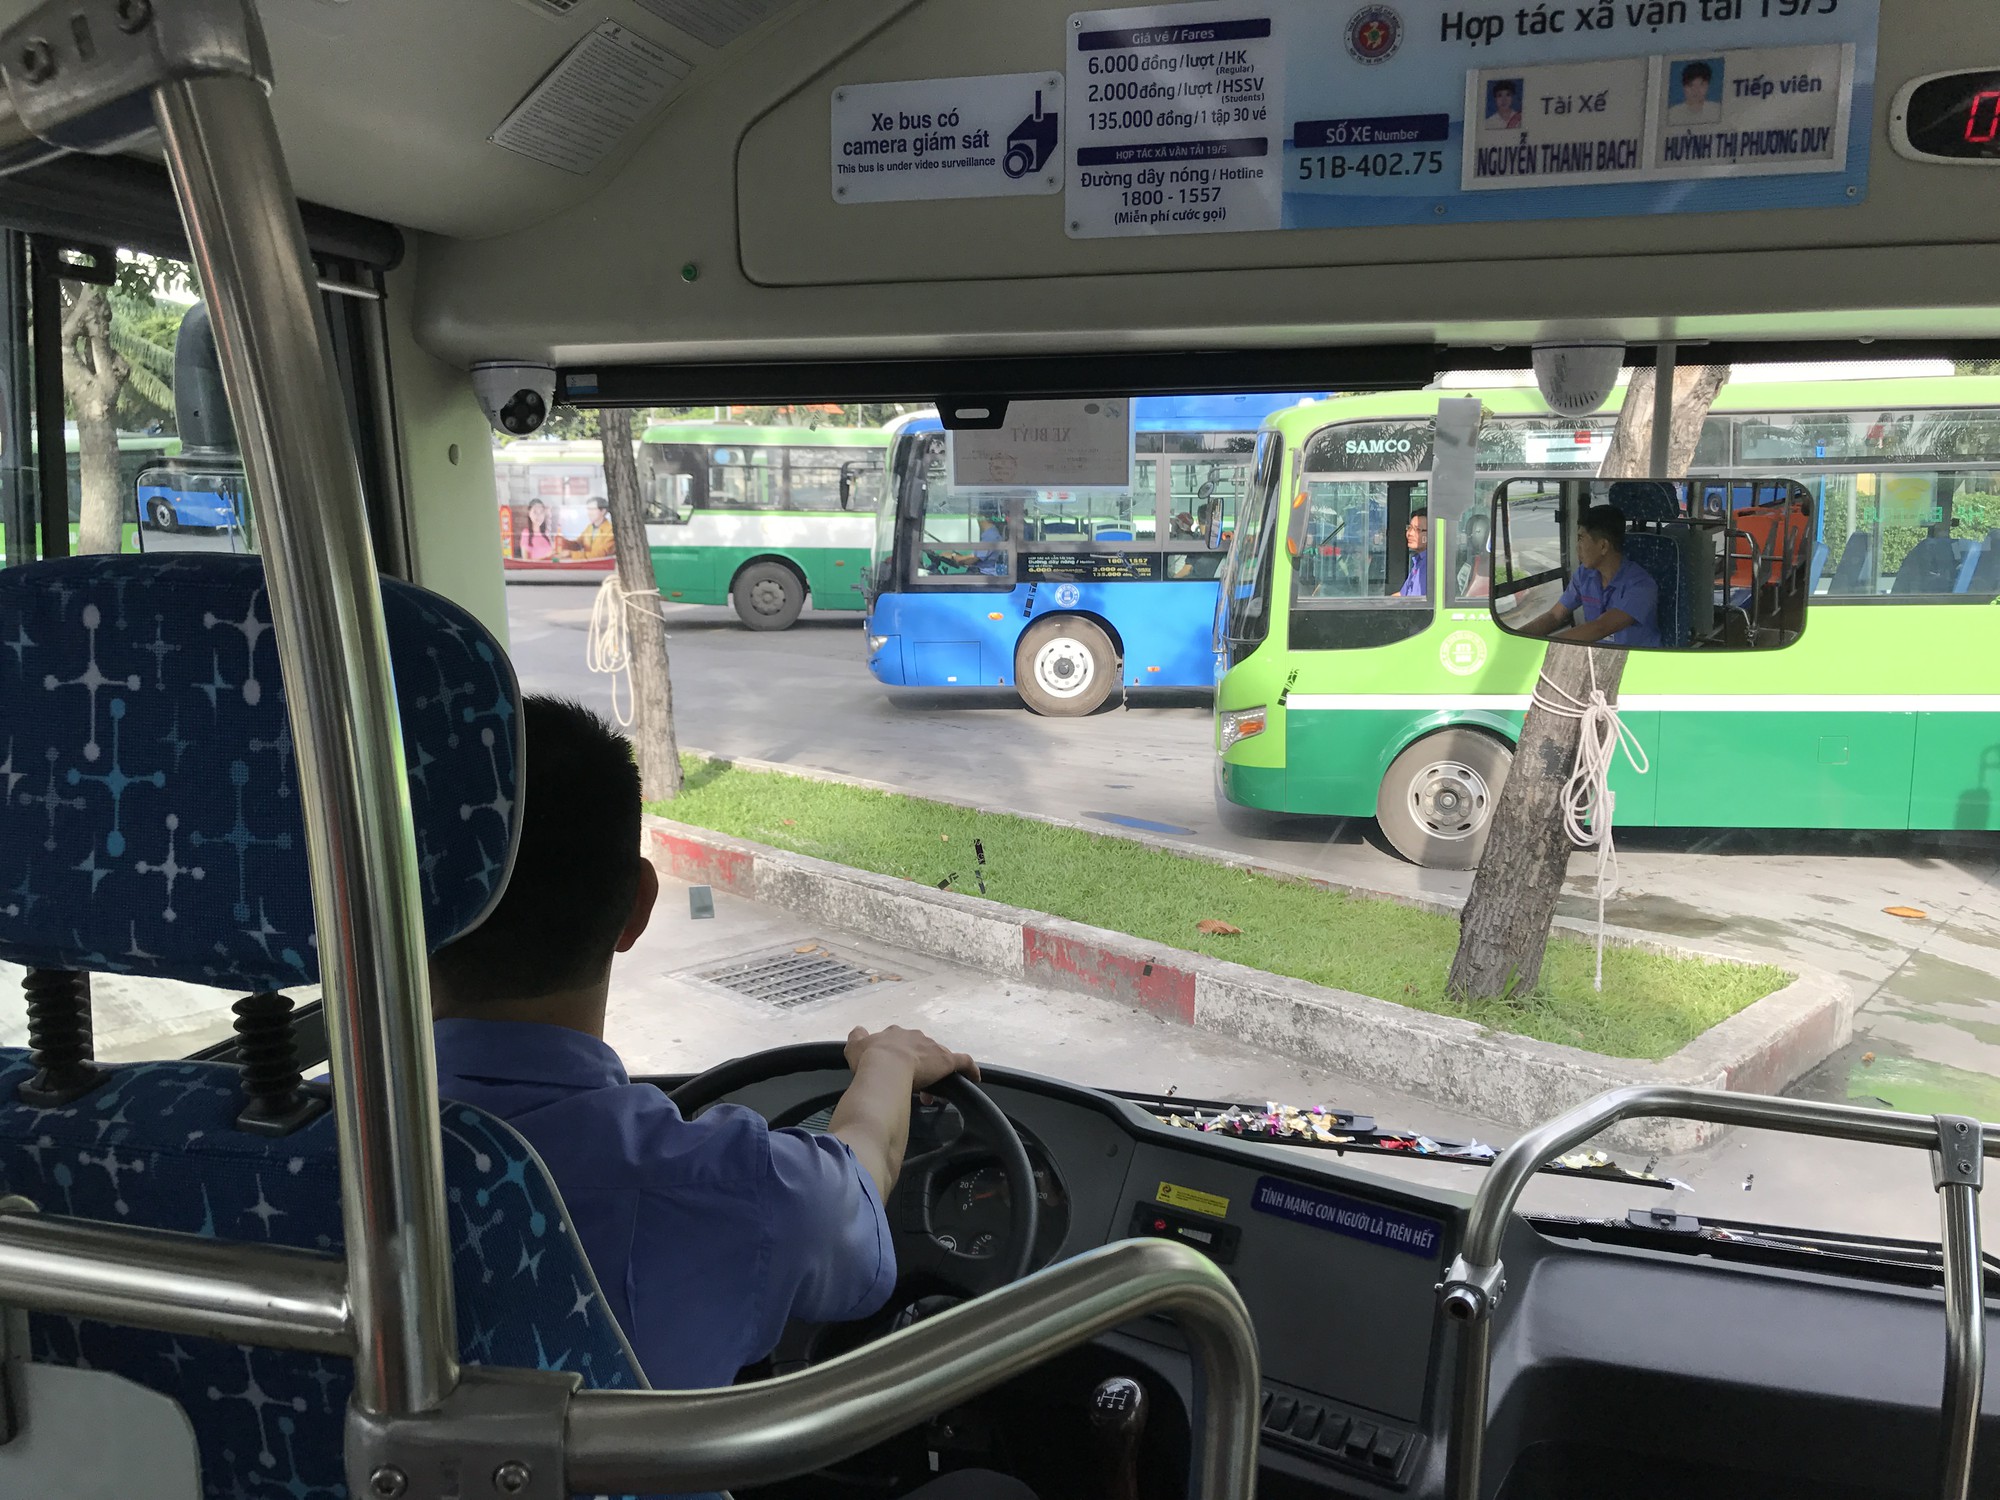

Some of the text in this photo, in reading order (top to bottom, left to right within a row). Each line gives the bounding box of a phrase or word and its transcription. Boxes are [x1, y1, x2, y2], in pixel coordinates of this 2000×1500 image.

[1132, 32, 1150, 45] Giá
[1154, 30, 1169, 43] vé
[1181, 28, 1215, 41] Fares
[1440, 11, 1504, 47] Hợp
[1515, 3, 1565, 37] tác
[1088, 54, 1139, 74] 6.000
[1216, 64, 1255, 75] (Regular)
[1732, 75, 1822, 99] Tiếp viên
[1221, 93, 1265, 105] (Students)
[1540, 89, 1609, 115] Tài Xế
[871, 107, 960, 132] Xe bus có
[1088, 110, 1153, 131] 135.000
[1211, 107, 1230, 125] tập
[1233, 107, 1249, 122] 30
[1252, 106, 1267, 121] vé
[842, 128, 990, 157] camera giám sát
[1326, 121, 1419, 144] SỐ XE Number
[1115, 149, 1134, 160] HỢP
[1137, 147, 1153, 159] TÁC
[1206, 144, 1228, 156] 19/5
[1477, 131, 1537, 177] NGUYỄN
[1541, 141, 1594, 175] THANH
[1664, 129, 1712, 161] HUỲNH
[1716, 132, 1738, 163] THỊ
[1800, 126, 1831, 154] DUY
[837, 163, 856, 174] This
[858, 162, 874, 173] bus
[886, 160, 913, 171] under
[914, 159, 939, 170] video
[941, 156, 996, 169] surveillance
[1299, 151, 1443, 180] 51B-402.75
[1080, 166, 1264, 188] Đường dây nóng / Hotline
[1121, 190, 1163, 206] 1800
[1179, 186, 1222, 204] 1557
[1114, 206, 1226, 226] (Miễn phí cước gọi)
[1345, 439, 1411, 454] SAMCO
[1260, 1187, 1435, 1249] TÍNH MẠNG CON NGƯỜI LÀ TRÊN HẾT
